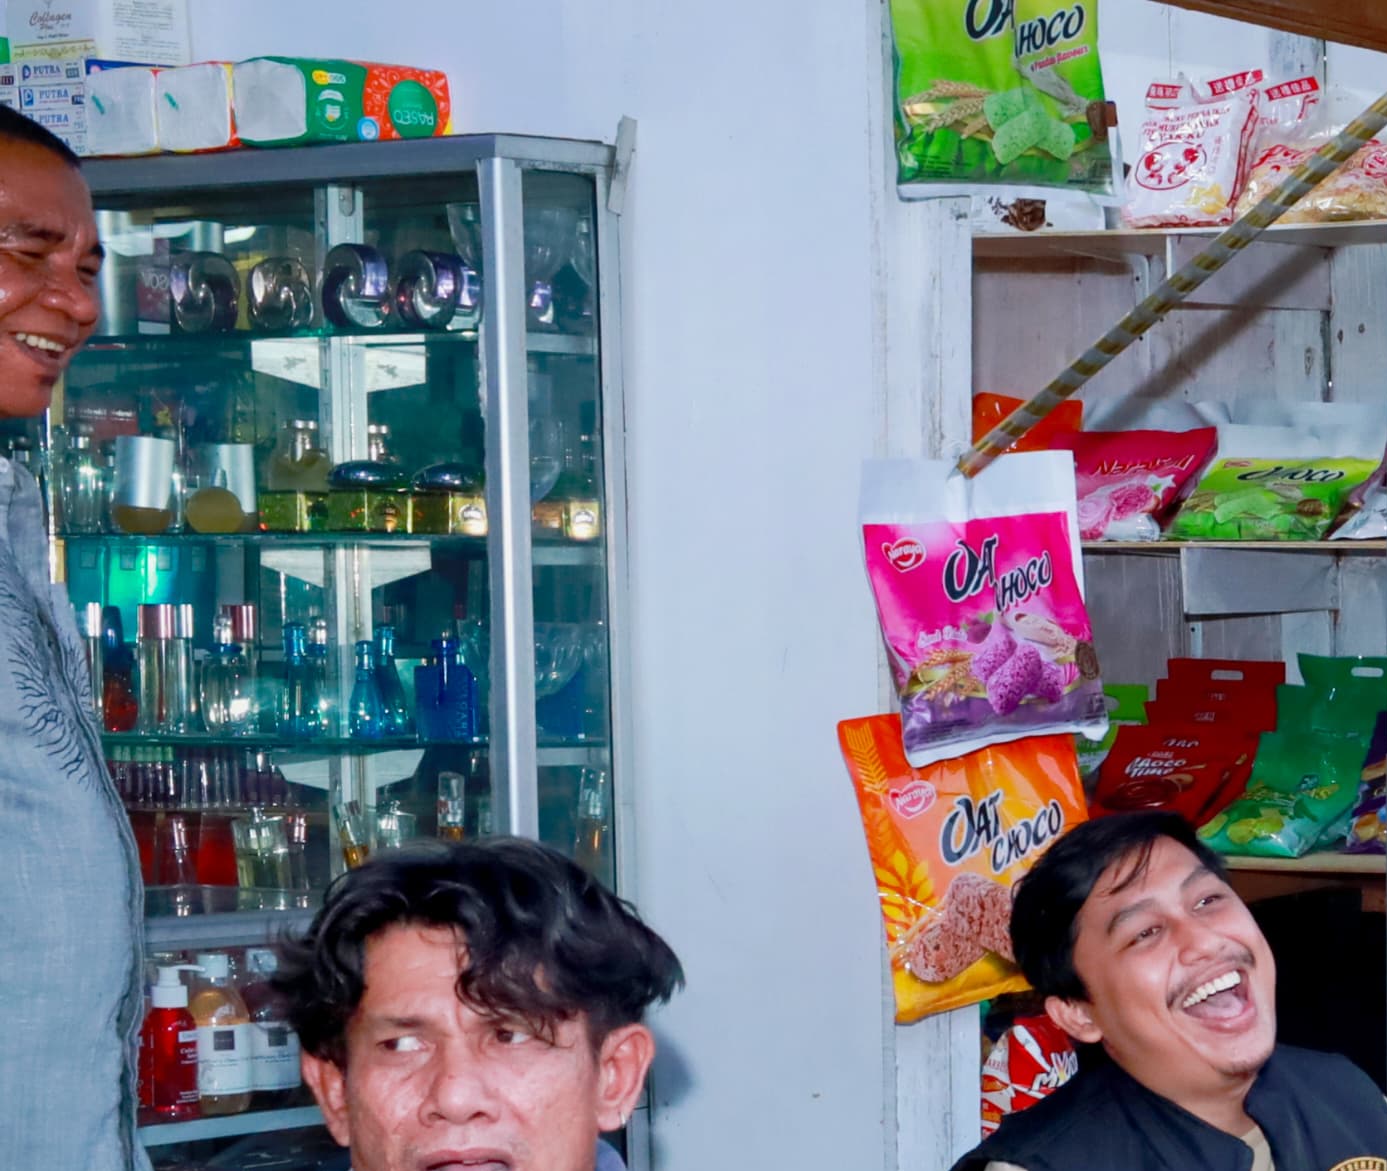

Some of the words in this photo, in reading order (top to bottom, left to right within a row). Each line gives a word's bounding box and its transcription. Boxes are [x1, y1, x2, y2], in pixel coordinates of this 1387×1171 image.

[966, 0, 1014, 39] OA
[1016, 6, 1085, 58] HOCO
[33, 65, 62, 75] PUTRA
[39, 88, 69, 99] PUTRA
[39, 113, 69, 124] PUTRA
[394, 109, 434, 126] PASEO
[895, 786, 935, 808] Naraya
[940, 790, 1002, 865] OAT
[991, 800, 1063, 874] CHOCO
